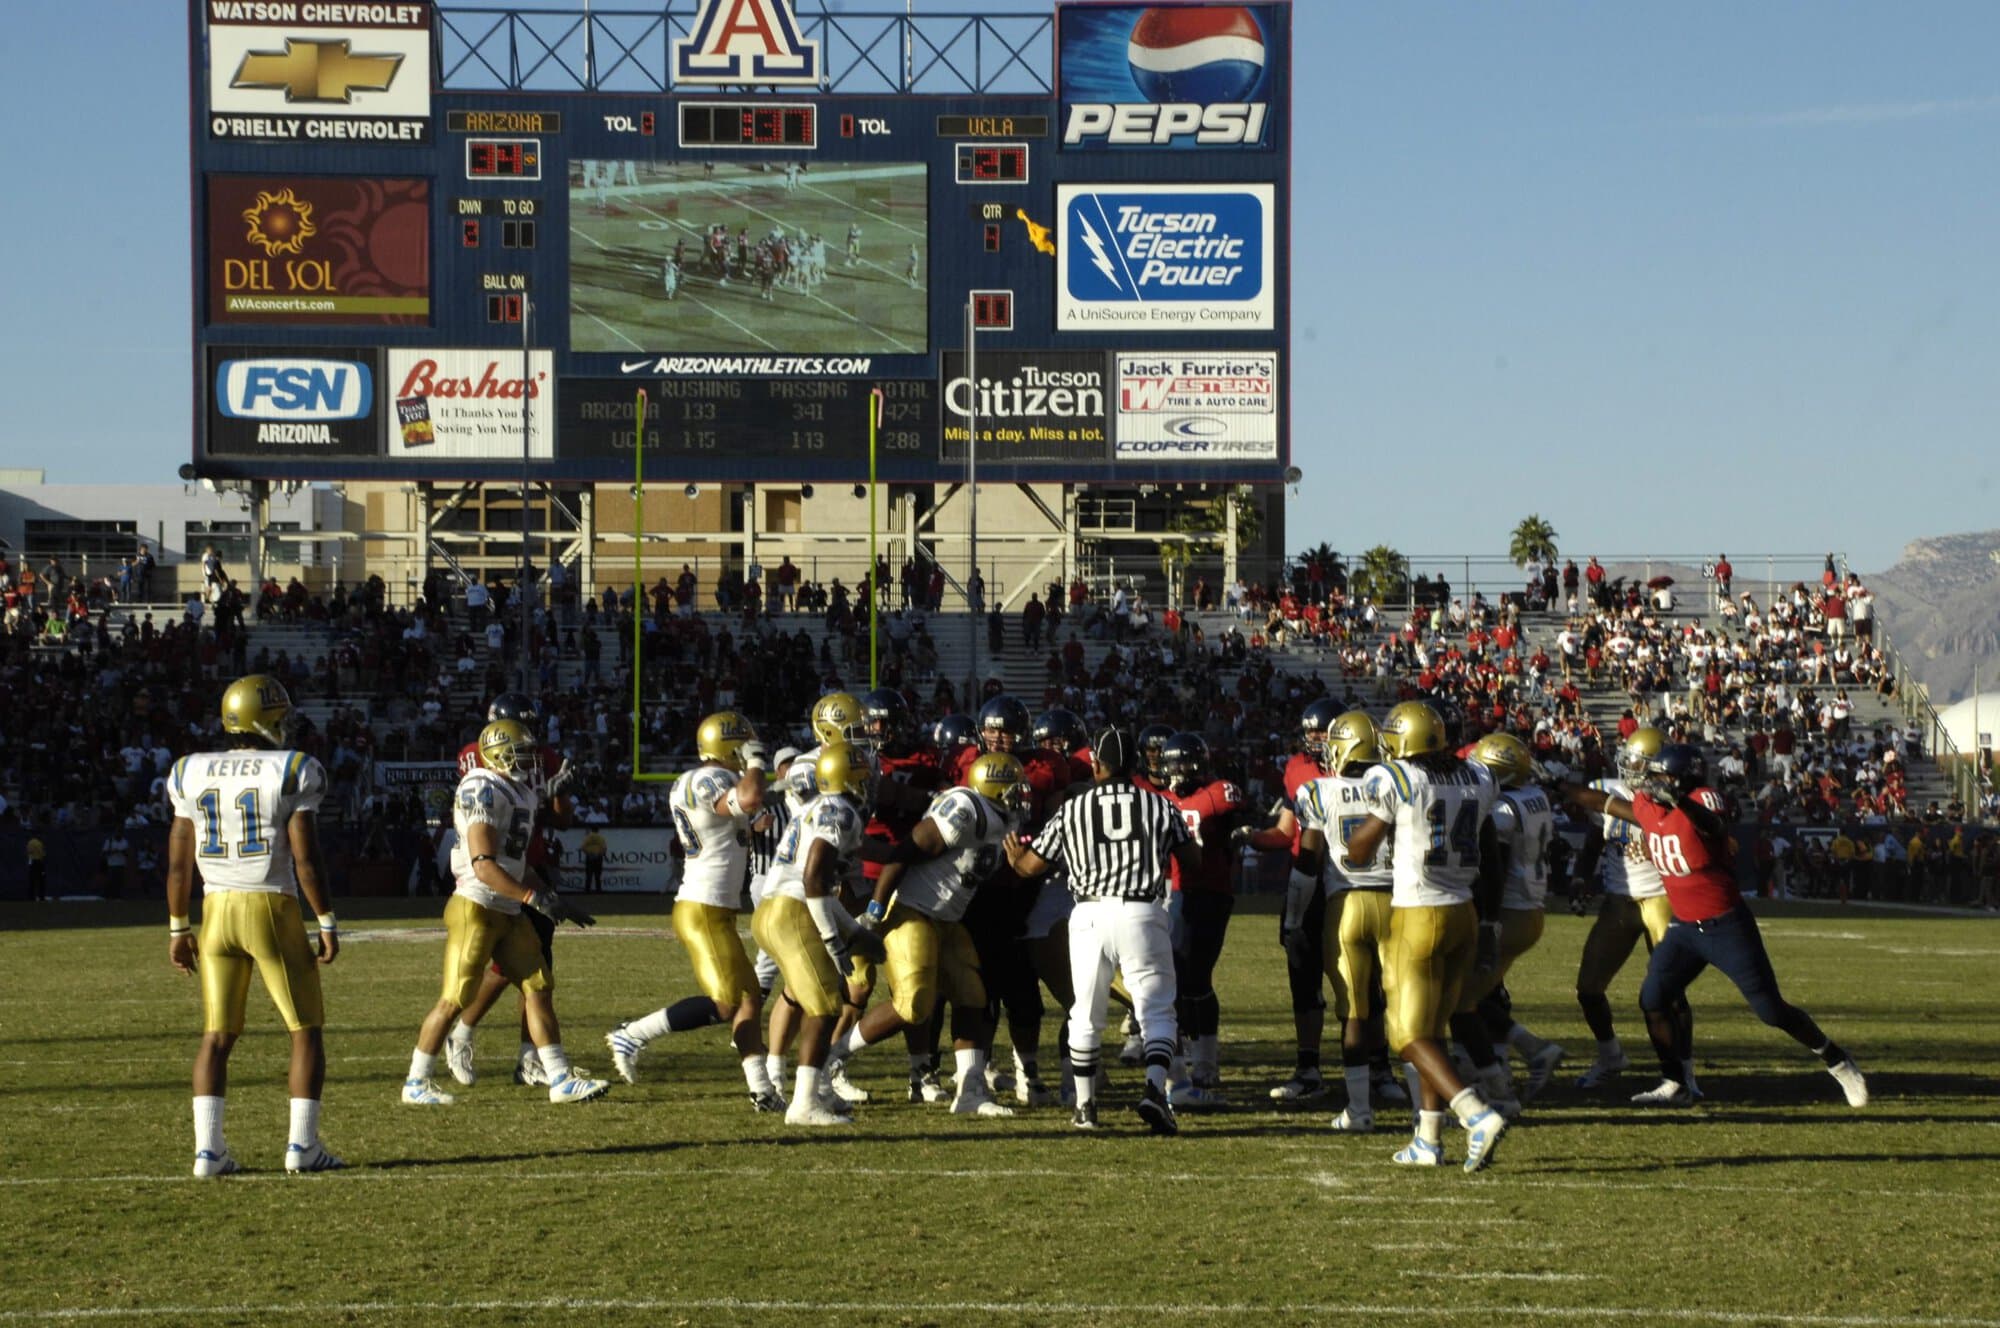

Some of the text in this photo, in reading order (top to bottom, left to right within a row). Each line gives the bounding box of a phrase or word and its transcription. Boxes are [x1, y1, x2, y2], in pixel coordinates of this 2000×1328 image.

[212, 1, 422, 24] WATSON CHEVROLET
[212, 118, 424, 140] O'RIELLY CHEVROLET
[466, 112, 542, 132] ARIZONA
[604, 116, 638, 132] TOL
[858, 119, 891, 135] TOL
[968, 118, 1014, 136] UCLA
[1063, 103, 1267, 144] PEPSI
[470, 143, 523, 174] 34
[974, 148, 1025, 178] 27
[458, 199, 482, 215] DWN
[503, 200, 535, 215] TO GO
[983, 204, 1003, 219] QTR
[1116, 206, 1217, 233] Tucson
[1127, 233, 1244, 259] Electric
[224, 259, 337, 291] DEL SOL
[483, 274, 525, 290] BALL ON
[1138, 260, 1243, 286] Power
[230, 298, 336, 311] AVAconcerts.com
[1066, 308, 1262, 323] A UniSource Energy Company
[653, 357, 872, 375] ARIZONAATHLETICS.COM
[1122, 361, 1270, 376] Jack Furrier's
[397, 358, 547, 399] Bashas'
[1021, 366, 1101, 387] Tucson
[241, 366, 348, 412] FSN
[661, 380, 742, 399] RUSHING
[768, 381, 848, 398] PASSING
[944, 376, 1105, 417] Citizen
[1122, 378, 1271, 411] WESTERN
[581, 402, 660, 419] ARIZOA
[683, 402, 716, 419] 133
[1168, 397, 1268, 407] TIRE & AUTO CARE
[455, 408, 494, 418] Thanks
[497, 408, 518, 418] You
[257, 424, 332, 444] ARIZONA
[436, 424, 473, 437] Saving
[476, 424, 497, 435] You
[885, 431, 921, 449] 288
[983, 429, 992, 441] a
[996, 427, 1025, 444] day.
[1030, 427, 1065, 441] Miss
[1068, 429, 1077, 441] a
[1081, 427, 1104, 441] lot.
[207, 759, 263, 777] KEYES
[196, 788, 270, 859] 11
[1098, 793, 1134, 841] U
[1424, 799, 1481, 868] 14
[1649, 832, 1692, 877] 88
